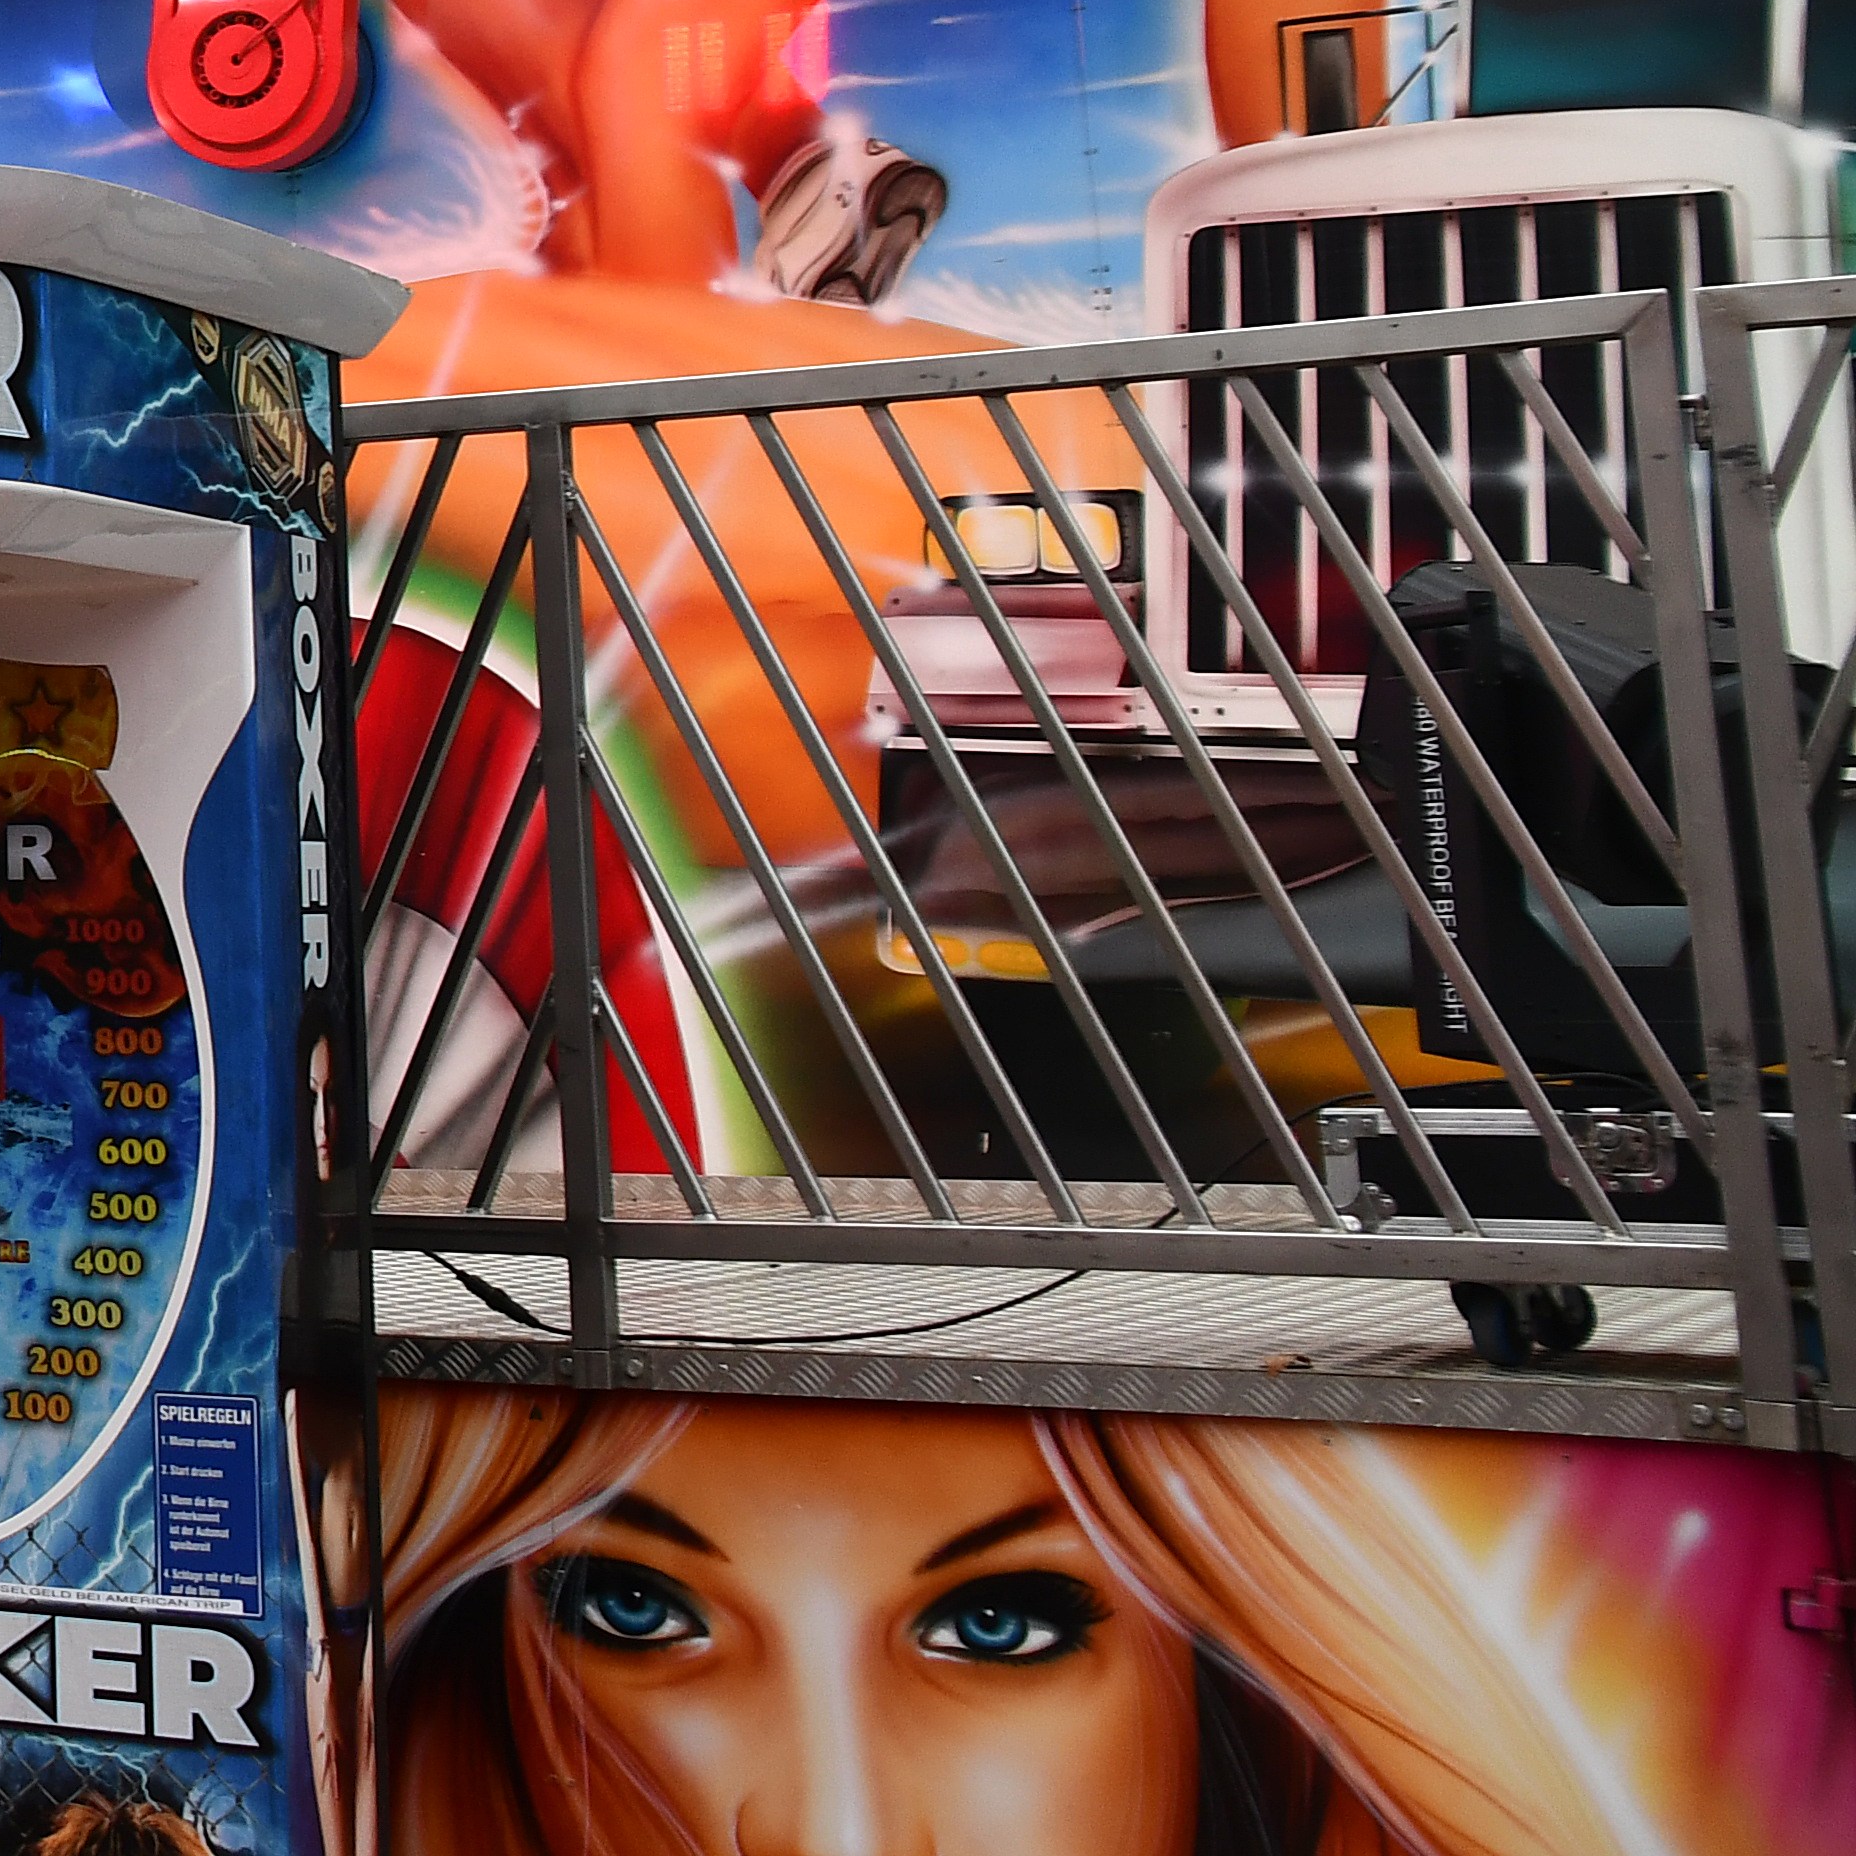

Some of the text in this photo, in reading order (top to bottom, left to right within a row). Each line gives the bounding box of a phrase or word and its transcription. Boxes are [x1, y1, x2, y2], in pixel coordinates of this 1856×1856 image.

[249, 374, 292, 453] MMA
[290, 535, 330, 992] BOXER
[1415, 736, 1454, 893] WATERPROOF
[66, 919, 145, 943] 1000
[87, 968, 152, 995] 900
[95, 1027, 163, 1056] 800
[101, 1080, 169, 1110] 700
[98, 1138, 167, 1165] 600
[90, 1192, 158, 1222] 500
[74, 1248, 143, 1276] 400
[51, 1298, 122, 1329] 300
[28, 1346, 100, 1377] 200
[4, 1391, 71, 1423] 100
[159, 1405, 252, 1425] SPIELREGELN
[76, 1591, 102, 1602] BEI
[106, 1593, 188, 1609] AMERICAN
[192, 1599, 231, 1610] TRIP
